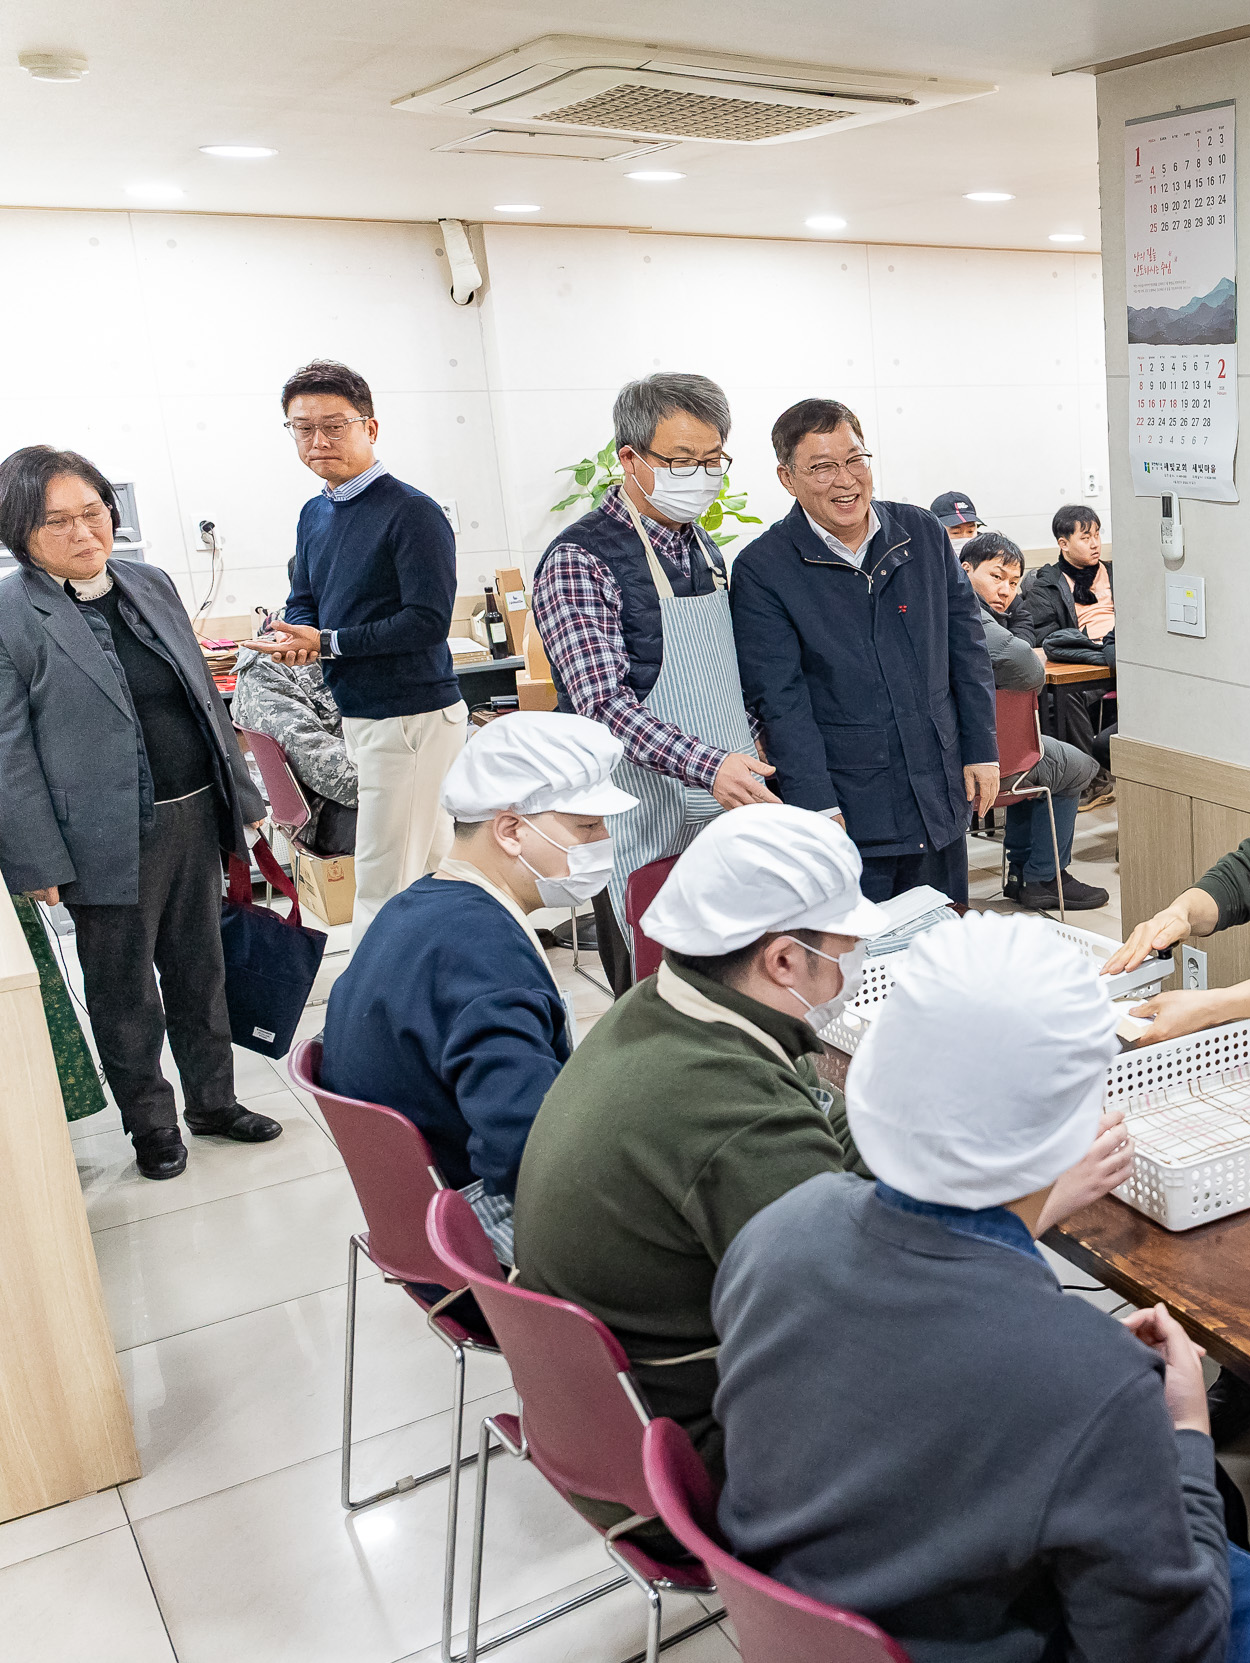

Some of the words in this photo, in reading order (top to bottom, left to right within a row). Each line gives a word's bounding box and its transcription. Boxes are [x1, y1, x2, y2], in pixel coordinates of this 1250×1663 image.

[1219, 154, 1226, 164] 10
[1150, 185, 1156, 195] 11
[1161, 183, 1168, 193] 12
[1173, 181, 1180, 191] 13
[1184, 180, 1191, 189] 14
[1195, 178, 1202, 187] 15
[1207, 176, 1214, 186] 16
[1219, 174, 1226, 184] 17
[1150, 204, 1157, 213] 18
[1161, 203, 1168, 212] 19
[1172, 201, 1180, 210] 20
[1183, 200, 1190, 209] 21
[1195, 198, 1203, 208] 22
[1207, 196, 1214, 206] 23
[1218, 195, 1226, 204] 24
[1150, 223, 1157, 232] 25
[1161, 222, 1169, 231] 26
[1172, 221, 1180, 230] 27
[1184, 219, 1191, 229] 28
[1195, 217, 1203, 227] 29
[1207, 216, 1214, 226] 30
[1219, 215, 1226, 224] 31
[1160, 381, 1166, 390] 10
[1170, 381, 1176, 390] 11
[1181, 381, 1188, 389] 12
[1193, 381, 1200, 389] 13
[1204, 380, 1211, 389] 14
[1138, 399, 1144, 408] 15
[1148, 399, 1155, 408] 16
[1159, 400, 1166, 408] 17
[1170, 400, 1177, 408] 18
[1181, 399, 1188, 408] 19
[1192, 399, 1199, 408] 20
[1203, 399, 1211, 408] 21
[1137, 417, 1144, 425] 22
[1147, 418, 1154, 426] 23
[1158, 418, 1165, 426] 24
[1169, 418, 1176, 426] 25
[1180, 418, 1188, 426] 26
[1191, 418, 1199, 427] 27
[1203, 418, 1210, 427] 28
